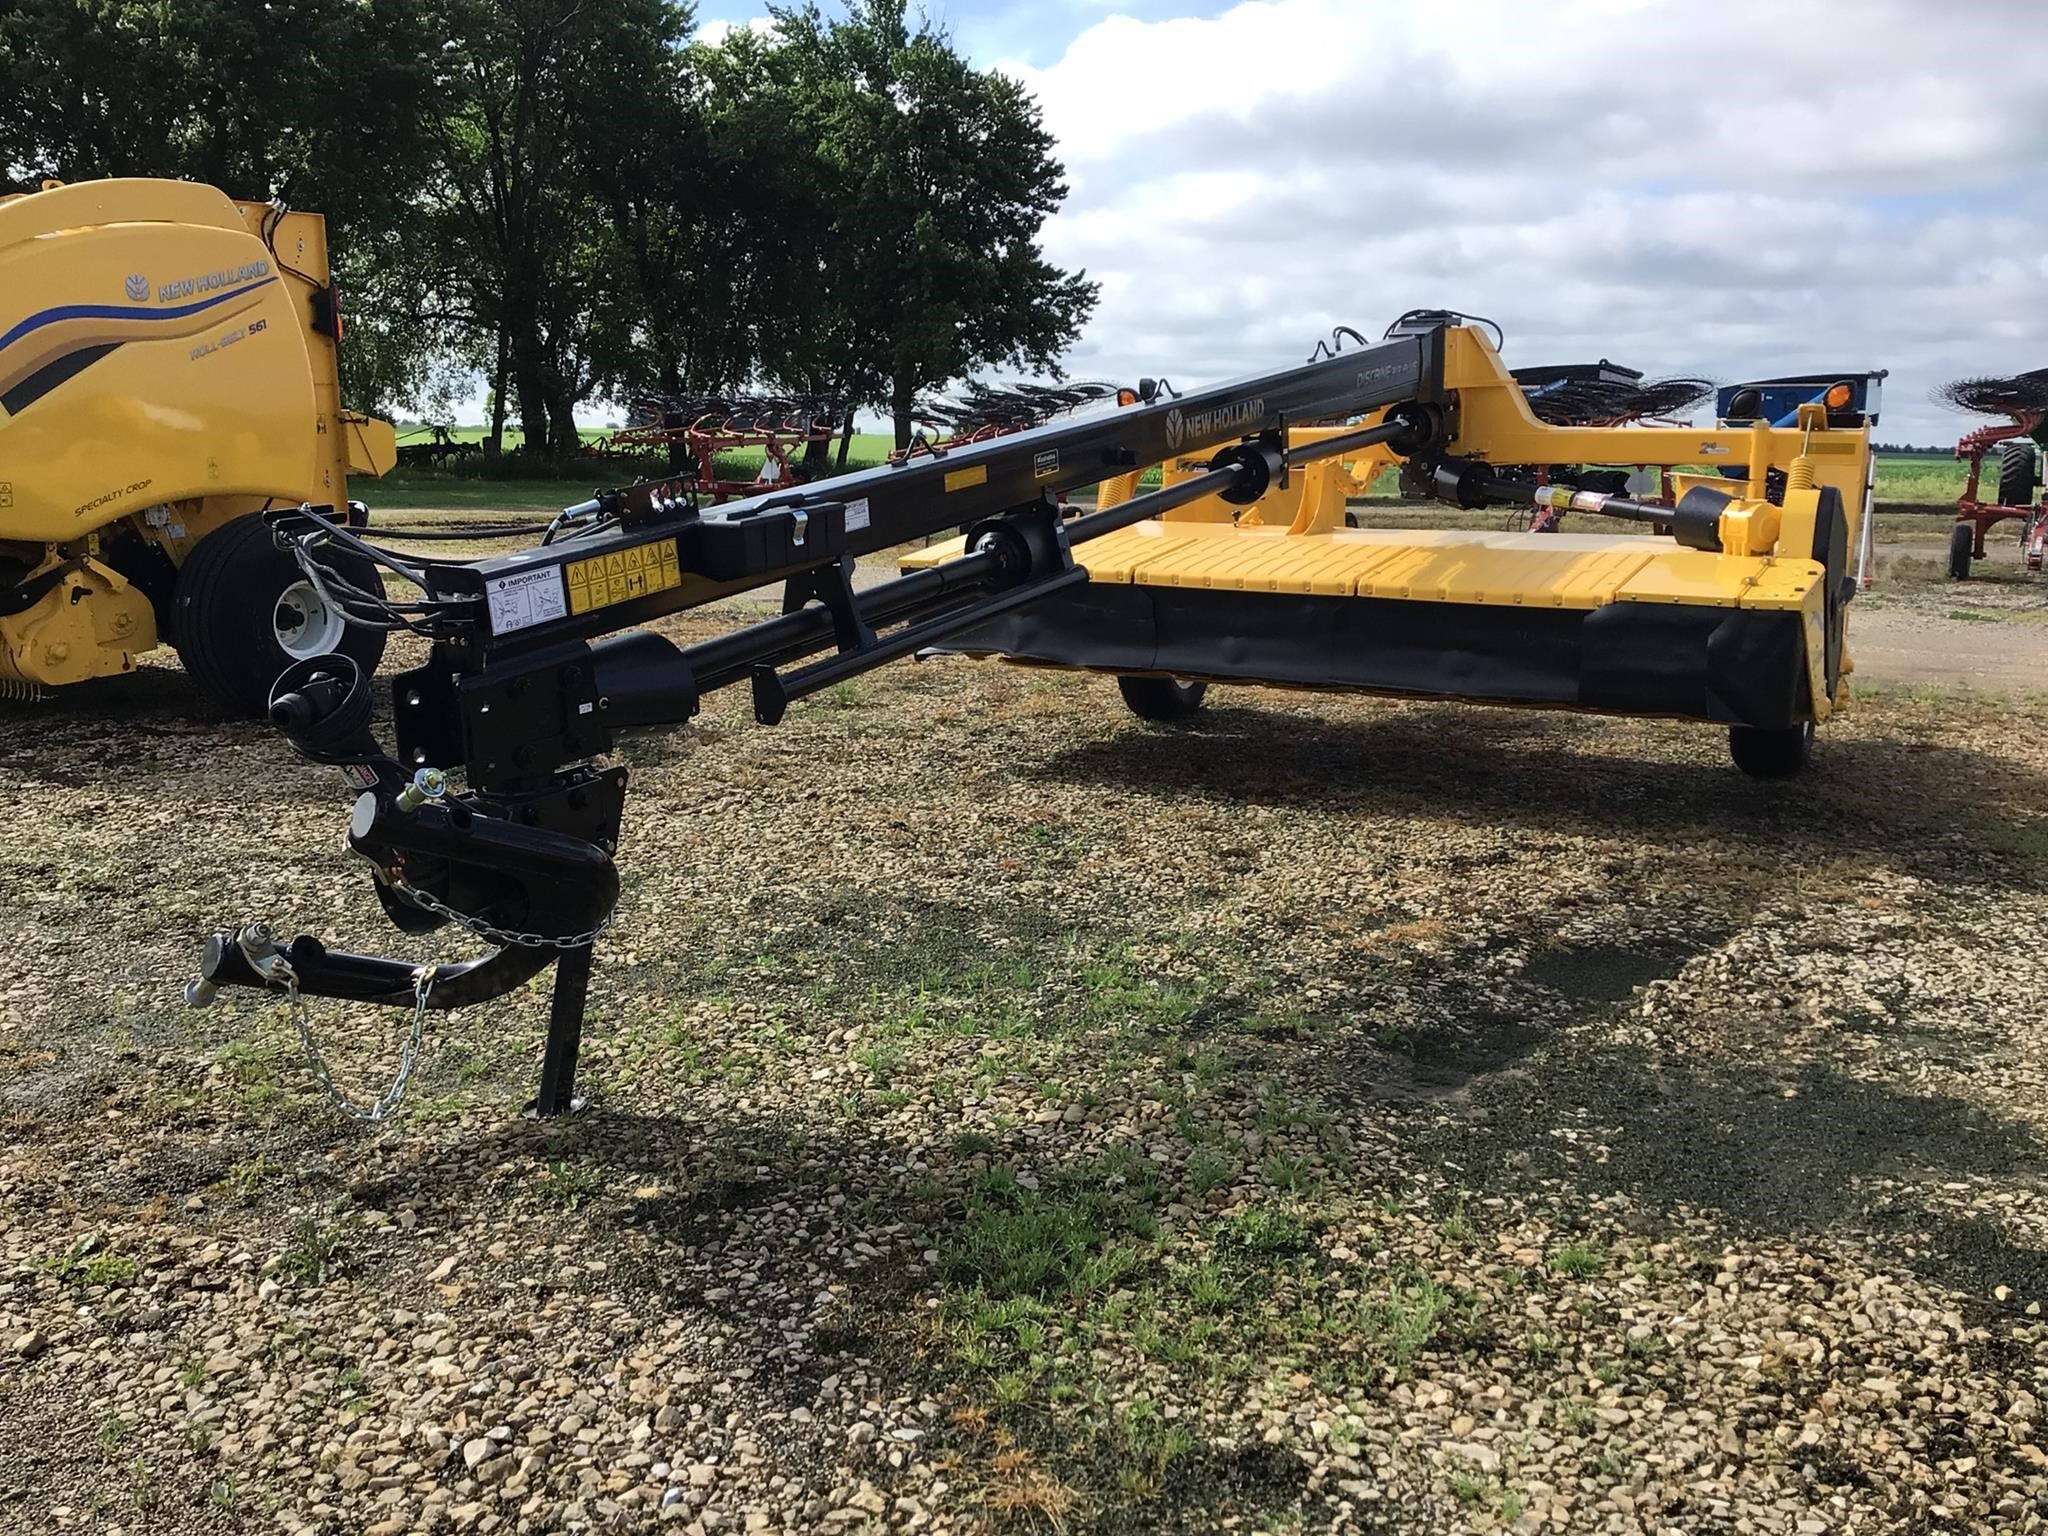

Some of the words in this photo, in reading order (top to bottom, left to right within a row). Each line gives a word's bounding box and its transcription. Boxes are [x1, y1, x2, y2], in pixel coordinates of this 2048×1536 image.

[158, 279, 194, 302] NEW
[197, 260, 269, 292] HOLLAND
[248, 319, 267, 335] 561
[1186, 414, 1211, 439] NEW
[1213, 399, 1265, 432] HOLLAND
[74, 489, 123, 517] SPECIALTY
[125, 479, 152, 494] CROP
[508, 570, 551, 587] IMPORTANT
